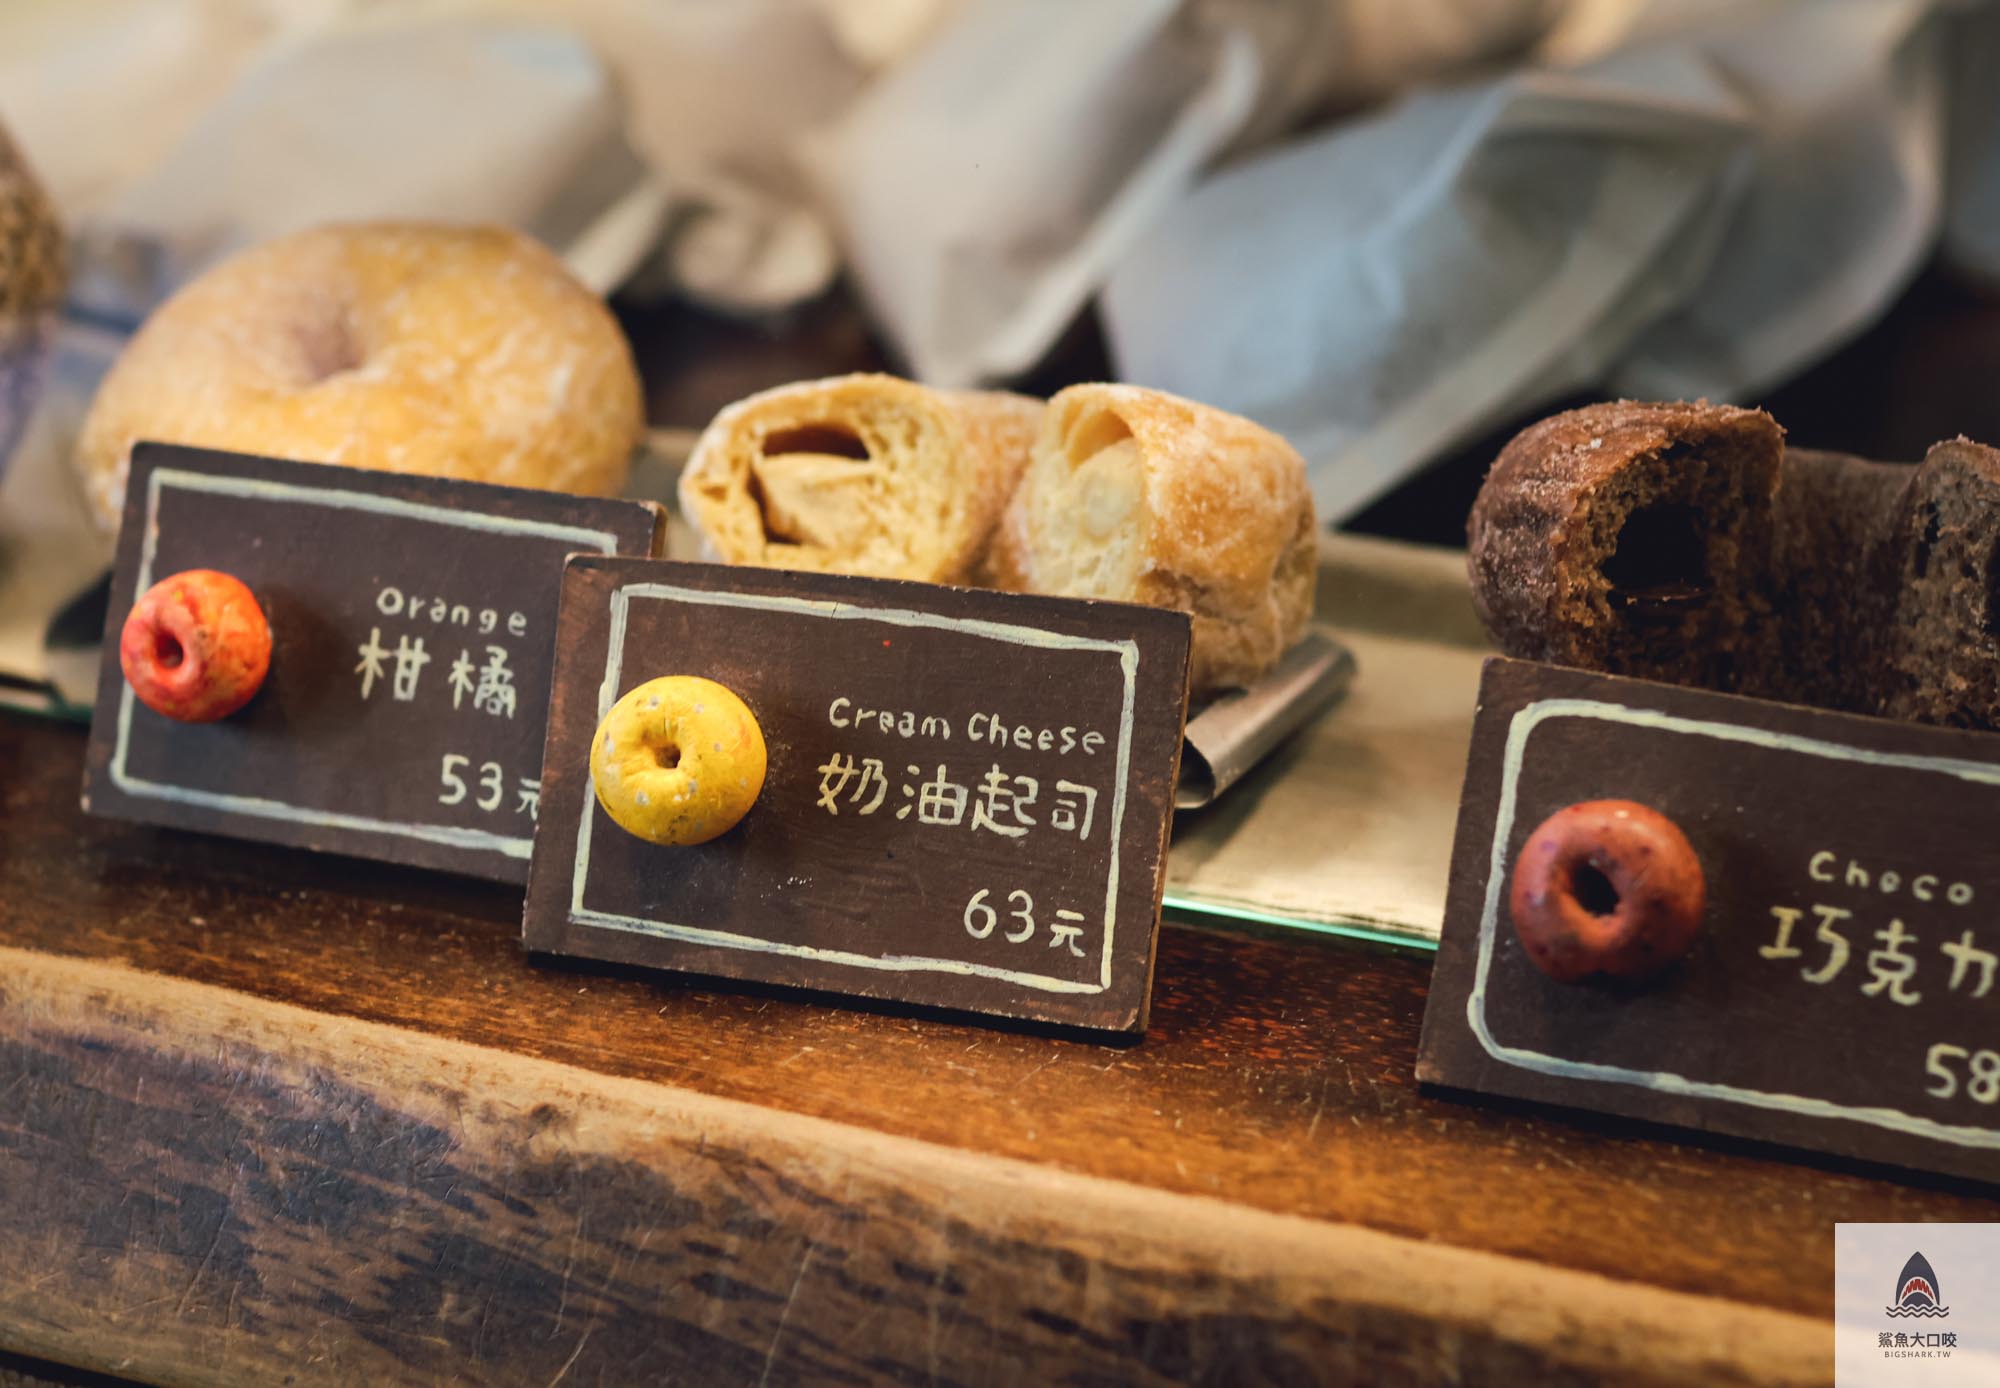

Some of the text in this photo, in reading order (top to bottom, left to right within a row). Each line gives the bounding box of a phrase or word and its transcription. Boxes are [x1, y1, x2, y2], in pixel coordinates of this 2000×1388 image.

[376, 586, 528, 637] Orange
[354, 626, 517, 720] 柑橘
[828, 697, 1106, 755] Cream Cheese
[438, 753, 541, 821] 53元
[816, 752, 1099, 840] 奶油起司
[1808, 850, 1974, 905] Choco
[963, 888, 1087, 957] 63元
[1758, 903, 1999, 1006] 巧克力
[1925, 1042, 2000, 1103] 58
